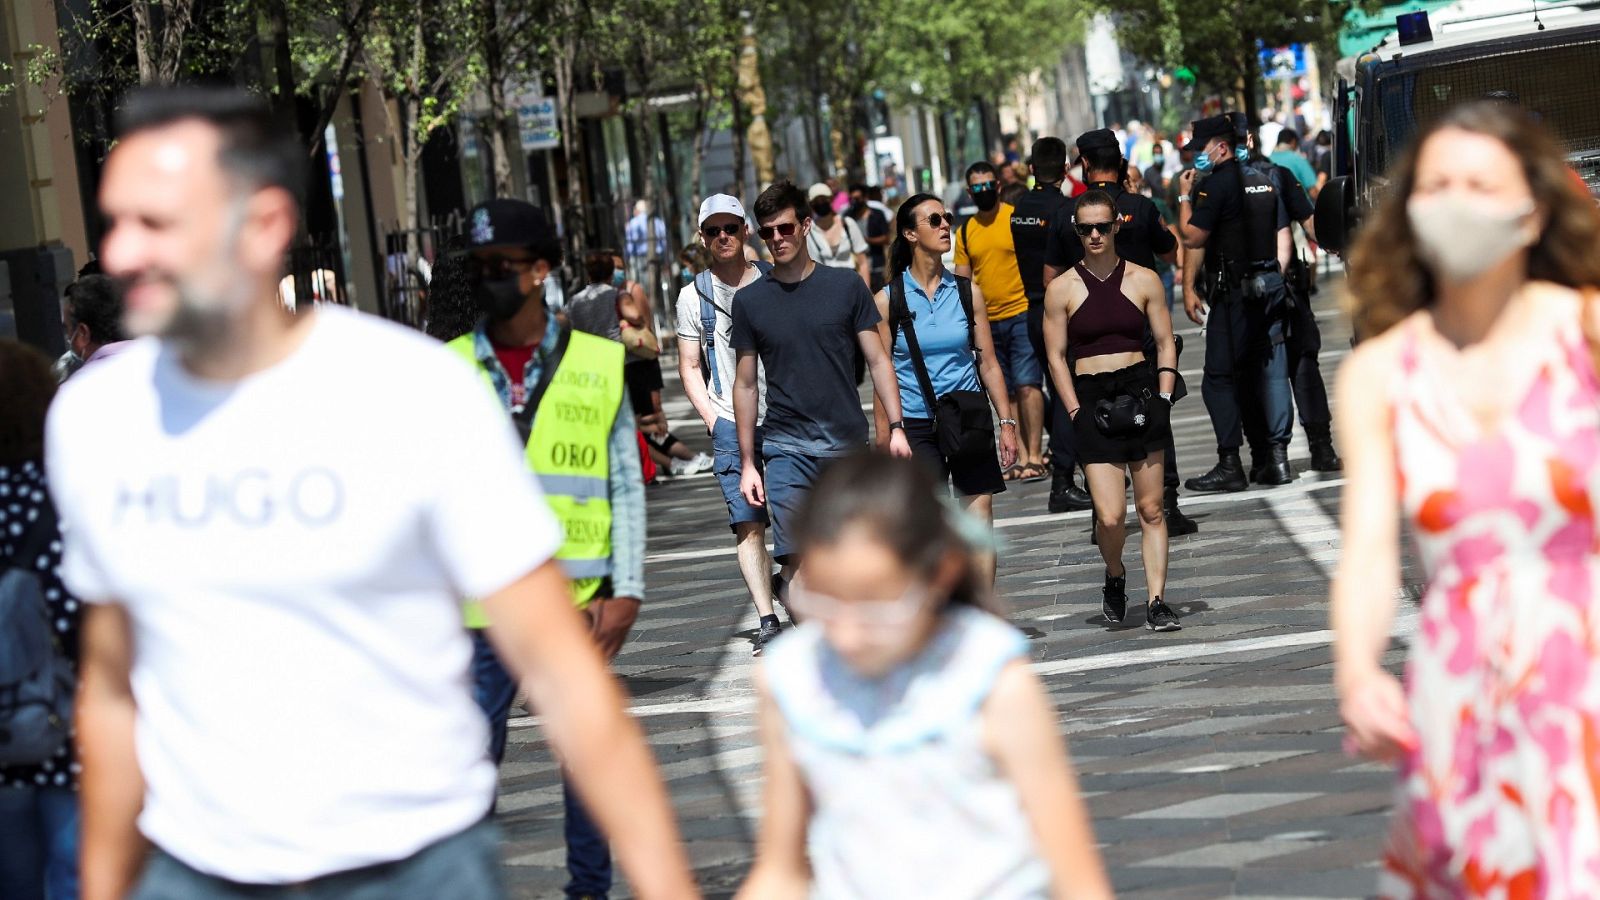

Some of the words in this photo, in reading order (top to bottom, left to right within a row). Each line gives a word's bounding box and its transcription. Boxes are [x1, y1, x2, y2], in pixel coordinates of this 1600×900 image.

[1010, 216, 1041, 226] POLICIA
[554, 402, 601, 426] VENTA
[551, 441, 597, 470] ORO
[112, 465, 347, 530] HUGO
